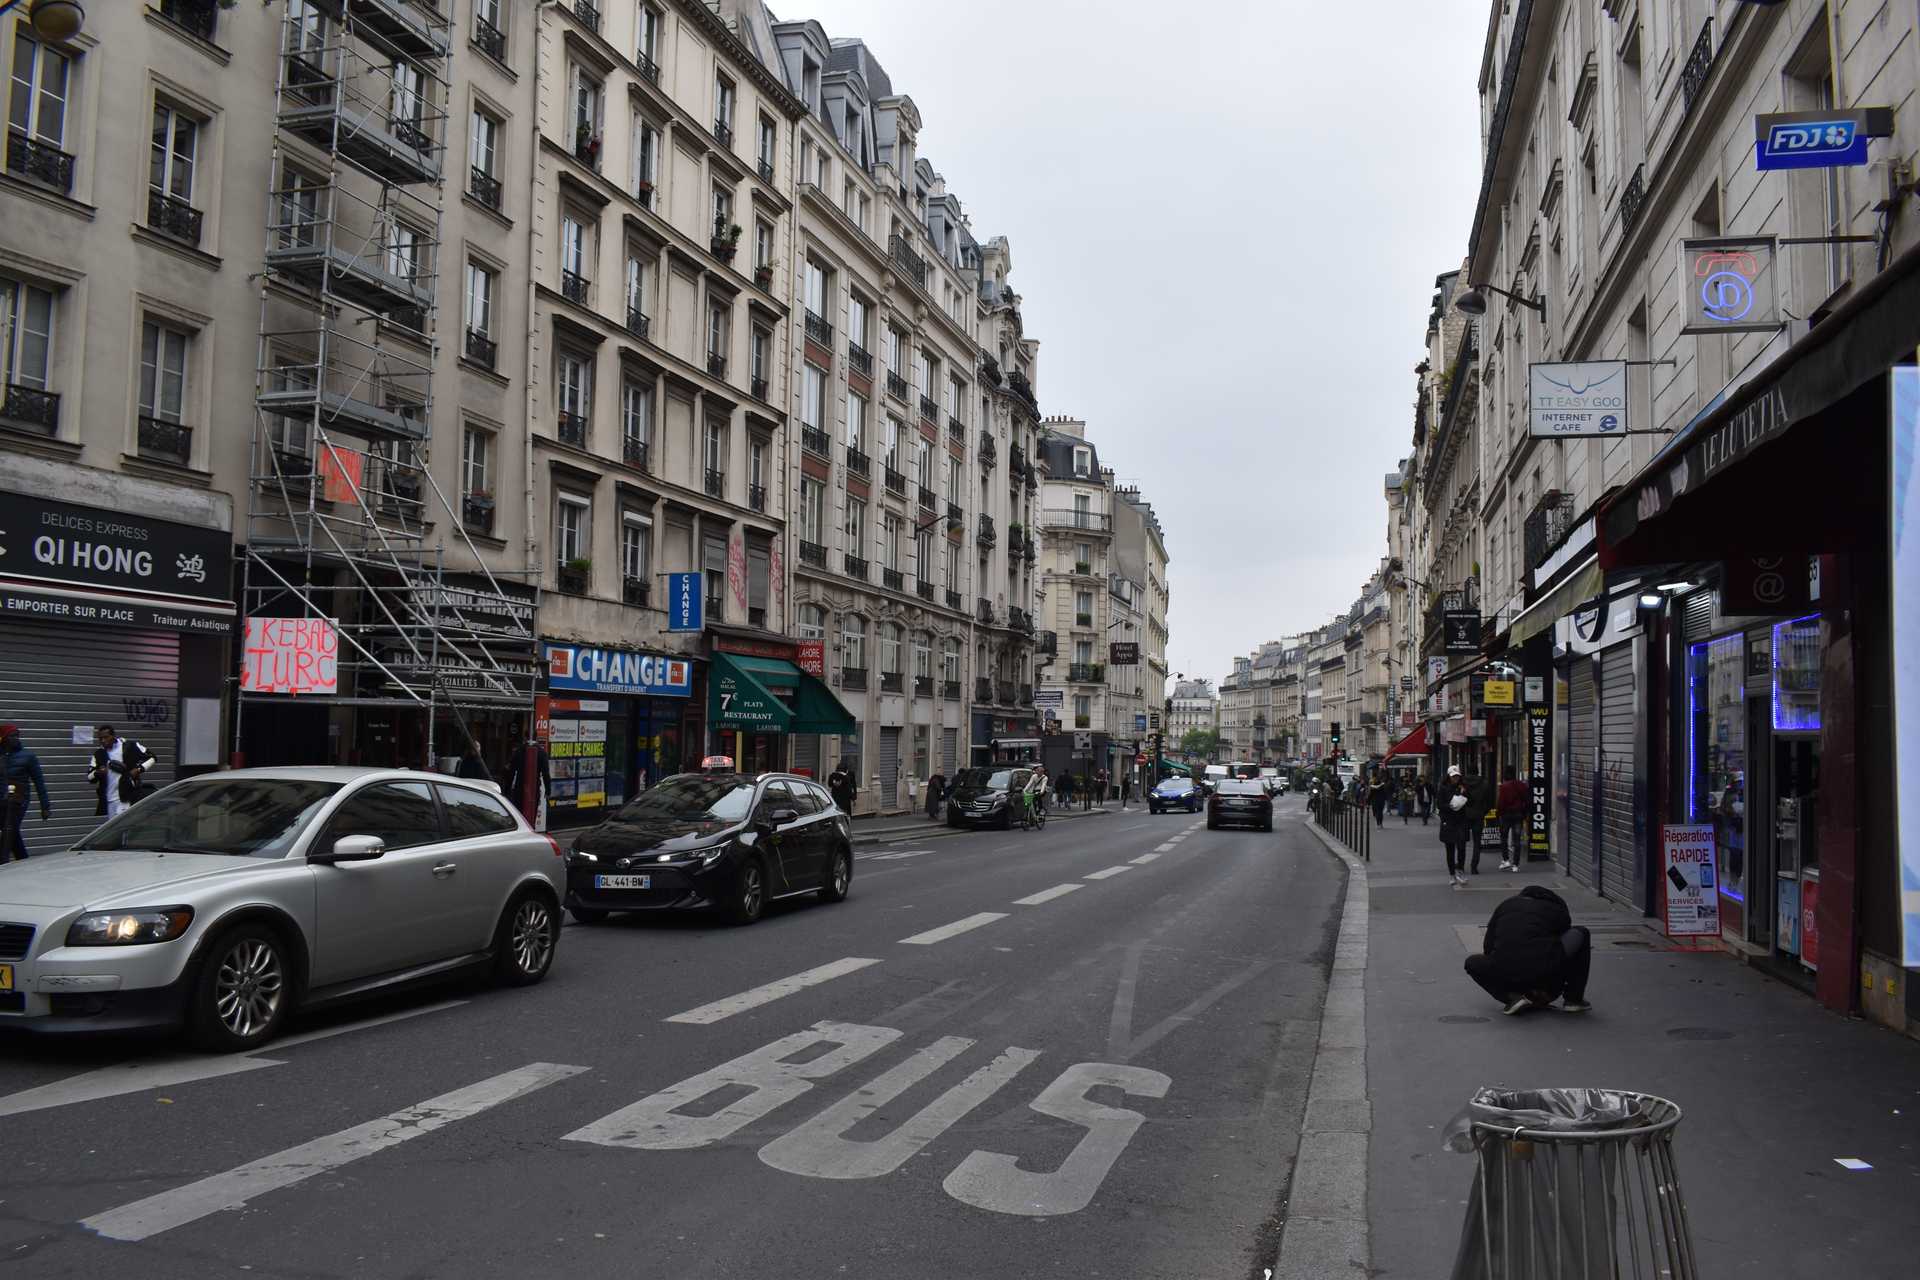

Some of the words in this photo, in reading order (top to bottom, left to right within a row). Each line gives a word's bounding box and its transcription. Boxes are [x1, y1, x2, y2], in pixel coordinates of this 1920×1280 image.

[1773, 128, 1823, 150] FDJ
[1557, 397, 1588, 407] EASY
[1593, 396, 1622, 408] GOO
[1542, 413, 1593, 422] INTERNET
[1552, 423, 1582, 432] CAFE
[1720, 384, 1789, 464] LUTETIA
[42, 512, 93, 533] DELICES
[96, 521, 149, 541] EXPRESS
[34, 535, 65, 567] QI
[72, 540, 153, 577] HONG
[176, 552, 206, 583] 鸿
[7, 598, 70, 615] EMPORTER
[75, 605, 96, 618] SUR
[100, 608, 134, 621] PLACE
[682, 574, 690, 626] CHANGE
[153, 613, 187, 627] Traiteur
[190, 615, 230, 632] Asiatique
[262, 618, 337, 654] KEBAB
[248, 647, 336, 688] TURC
[576, 649, 665, 686] CHANGE
[724, 711, 773, 720] RESTAURANT
[551, 742, 573, 758] BUREAU
[582, 742, 604, 757] CHANGE
[1531, 718, 1546, 778] WESTERN
[1532, 787, 1545, 830] UNION
[1664, 829, 1714, 846] Réparation
[1670, 848, 1710, 863] RAPIDE
[560, 1019, 1173, 1217] BUS
